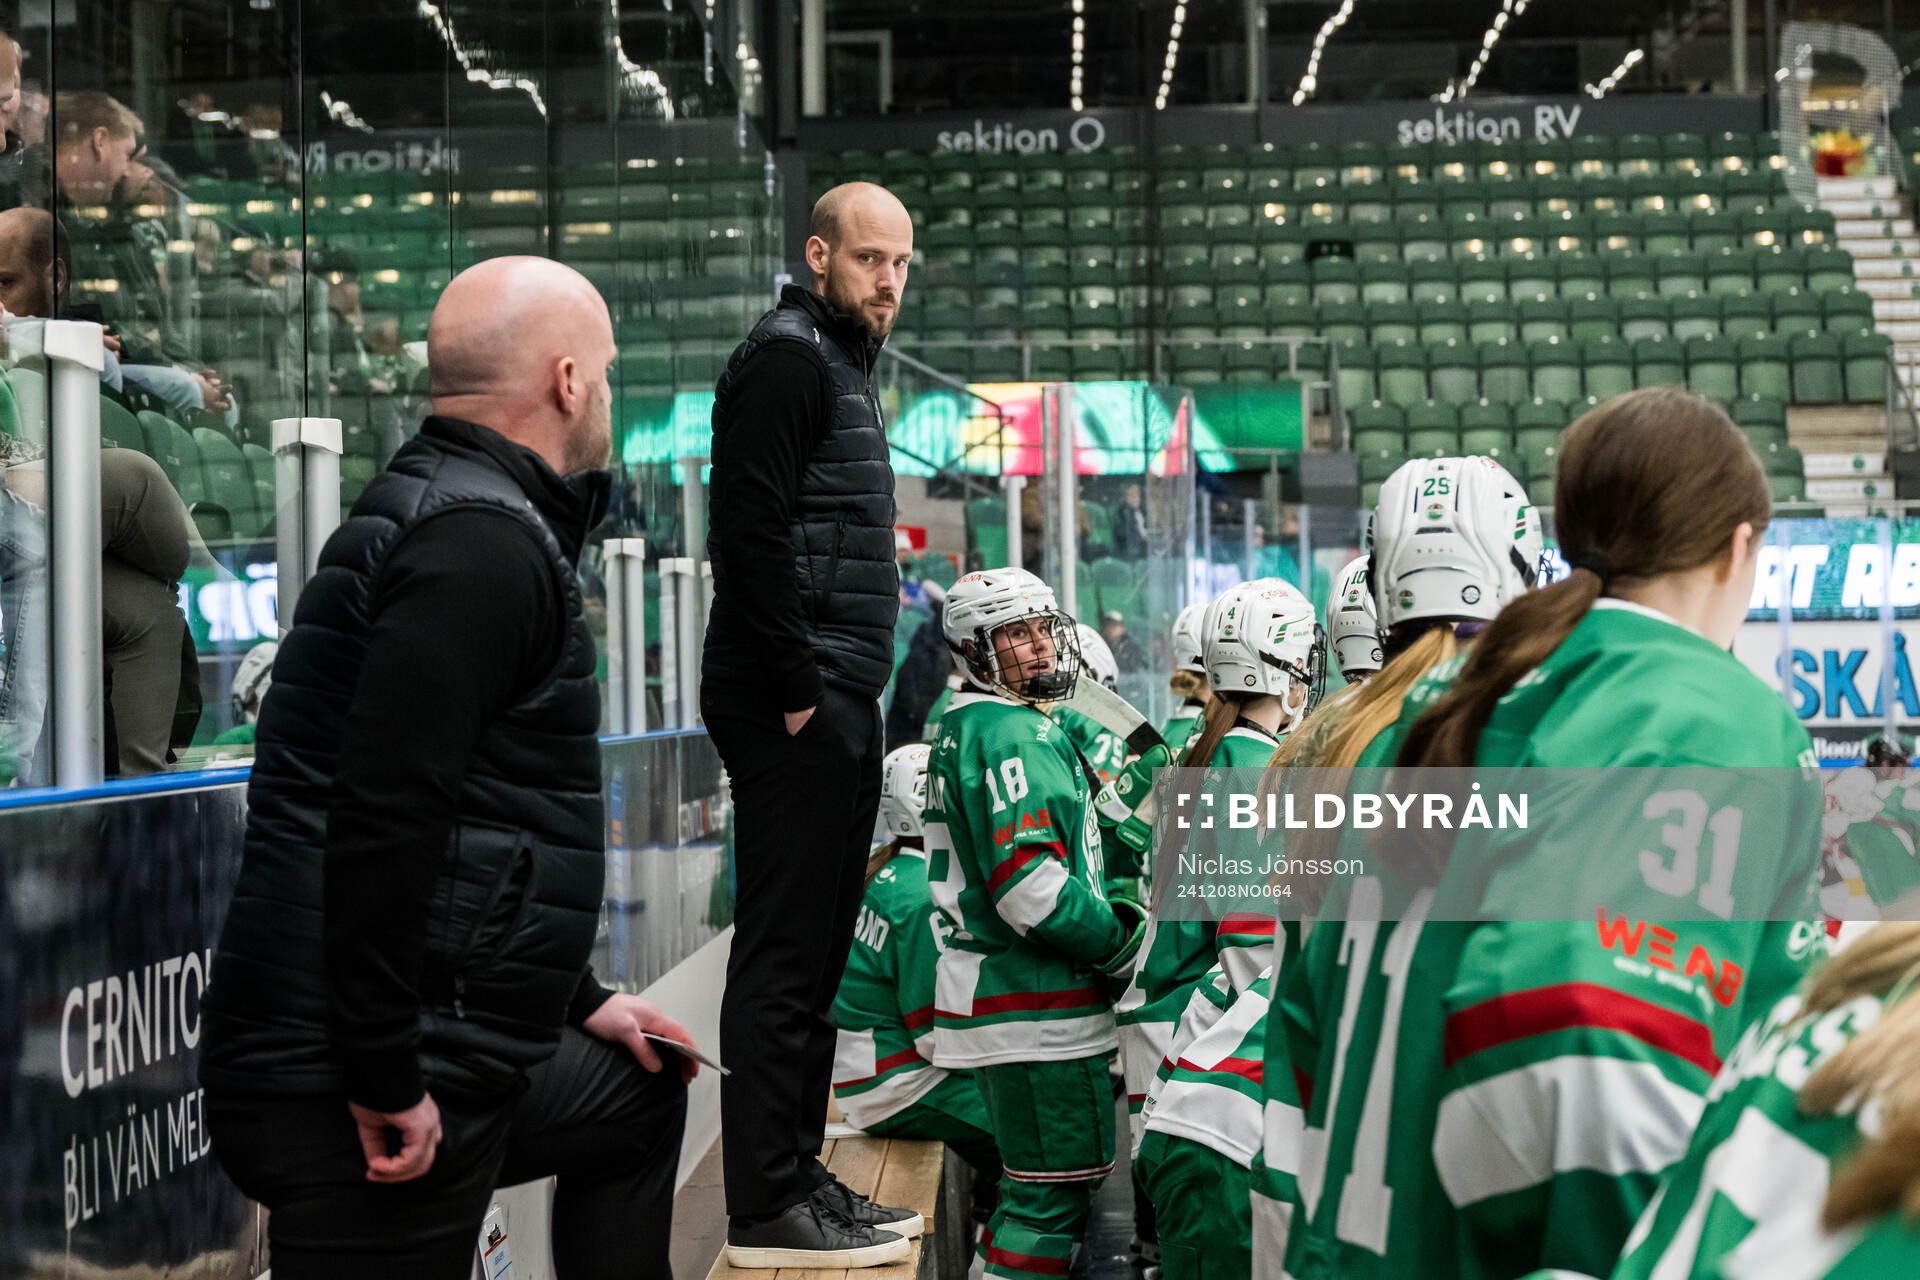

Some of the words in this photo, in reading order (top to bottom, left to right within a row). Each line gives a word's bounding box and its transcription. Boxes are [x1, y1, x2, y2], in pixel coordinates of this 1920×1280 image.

[936, 118, 1058, 153] sektion
[1070, 116, 1106, 152] O
[1397, 105, 1521, 146] sektion
[1534, 103, 1582, 144] RV
[1423, 476, 1451, 497] 25
[1350, 569, 1368, 585] 10
[1227, 606, 1237, 620] 4
[985, 756, 1029, 815] 18
[1637, 788, 1744, 921] 31
[1595, 905, 1745, 1008] WEAB
[62, 1136, 101, 1232] BLI
[105, 1102, 161, 1203] VÄN
